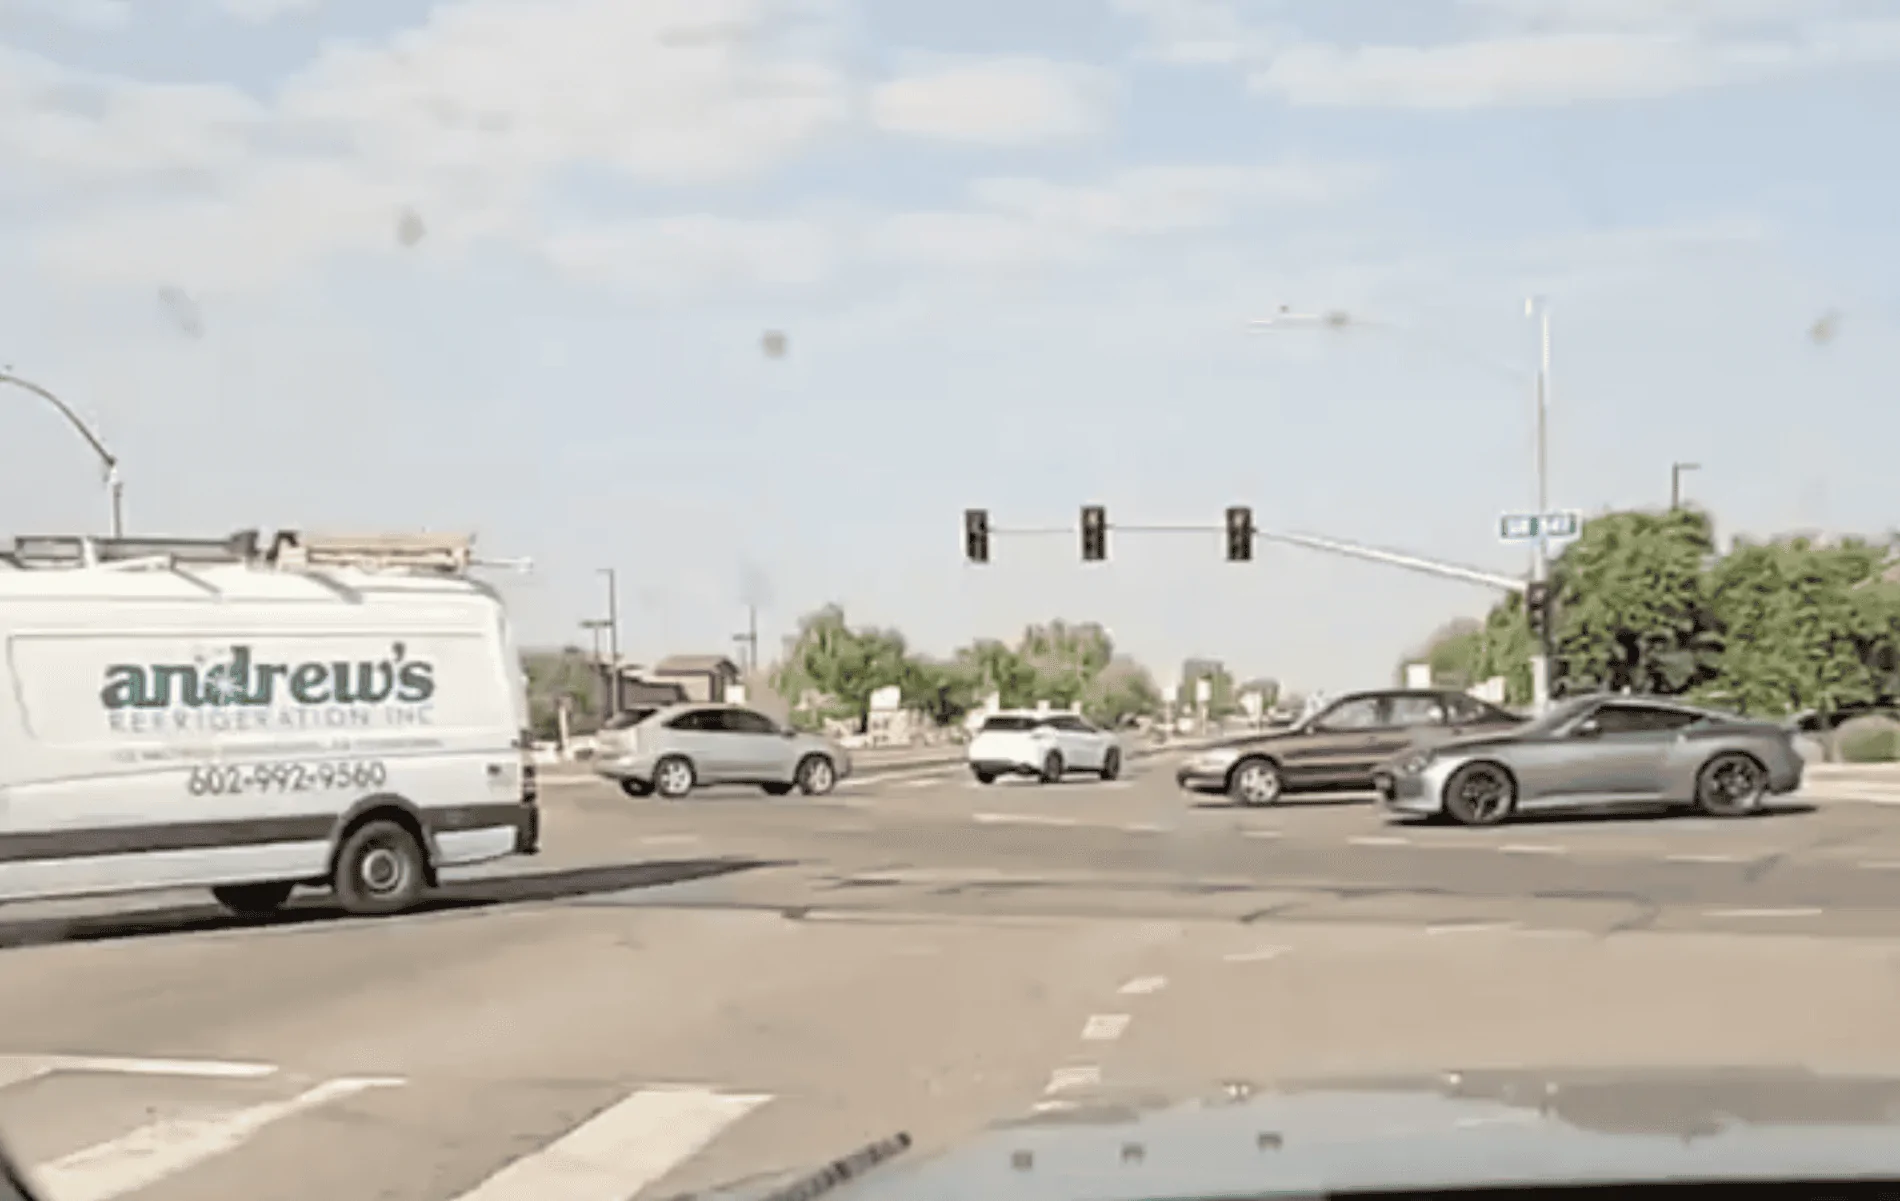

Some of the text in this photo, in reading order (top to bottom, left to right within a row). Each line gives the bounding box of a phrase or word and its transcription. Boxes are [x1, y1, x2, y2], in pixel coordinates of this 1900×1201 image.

[101, 642, 435, 709] andrew's
[385, 704, 435, 726] INC
[188, 762, 386, 796] 602-992-9560
